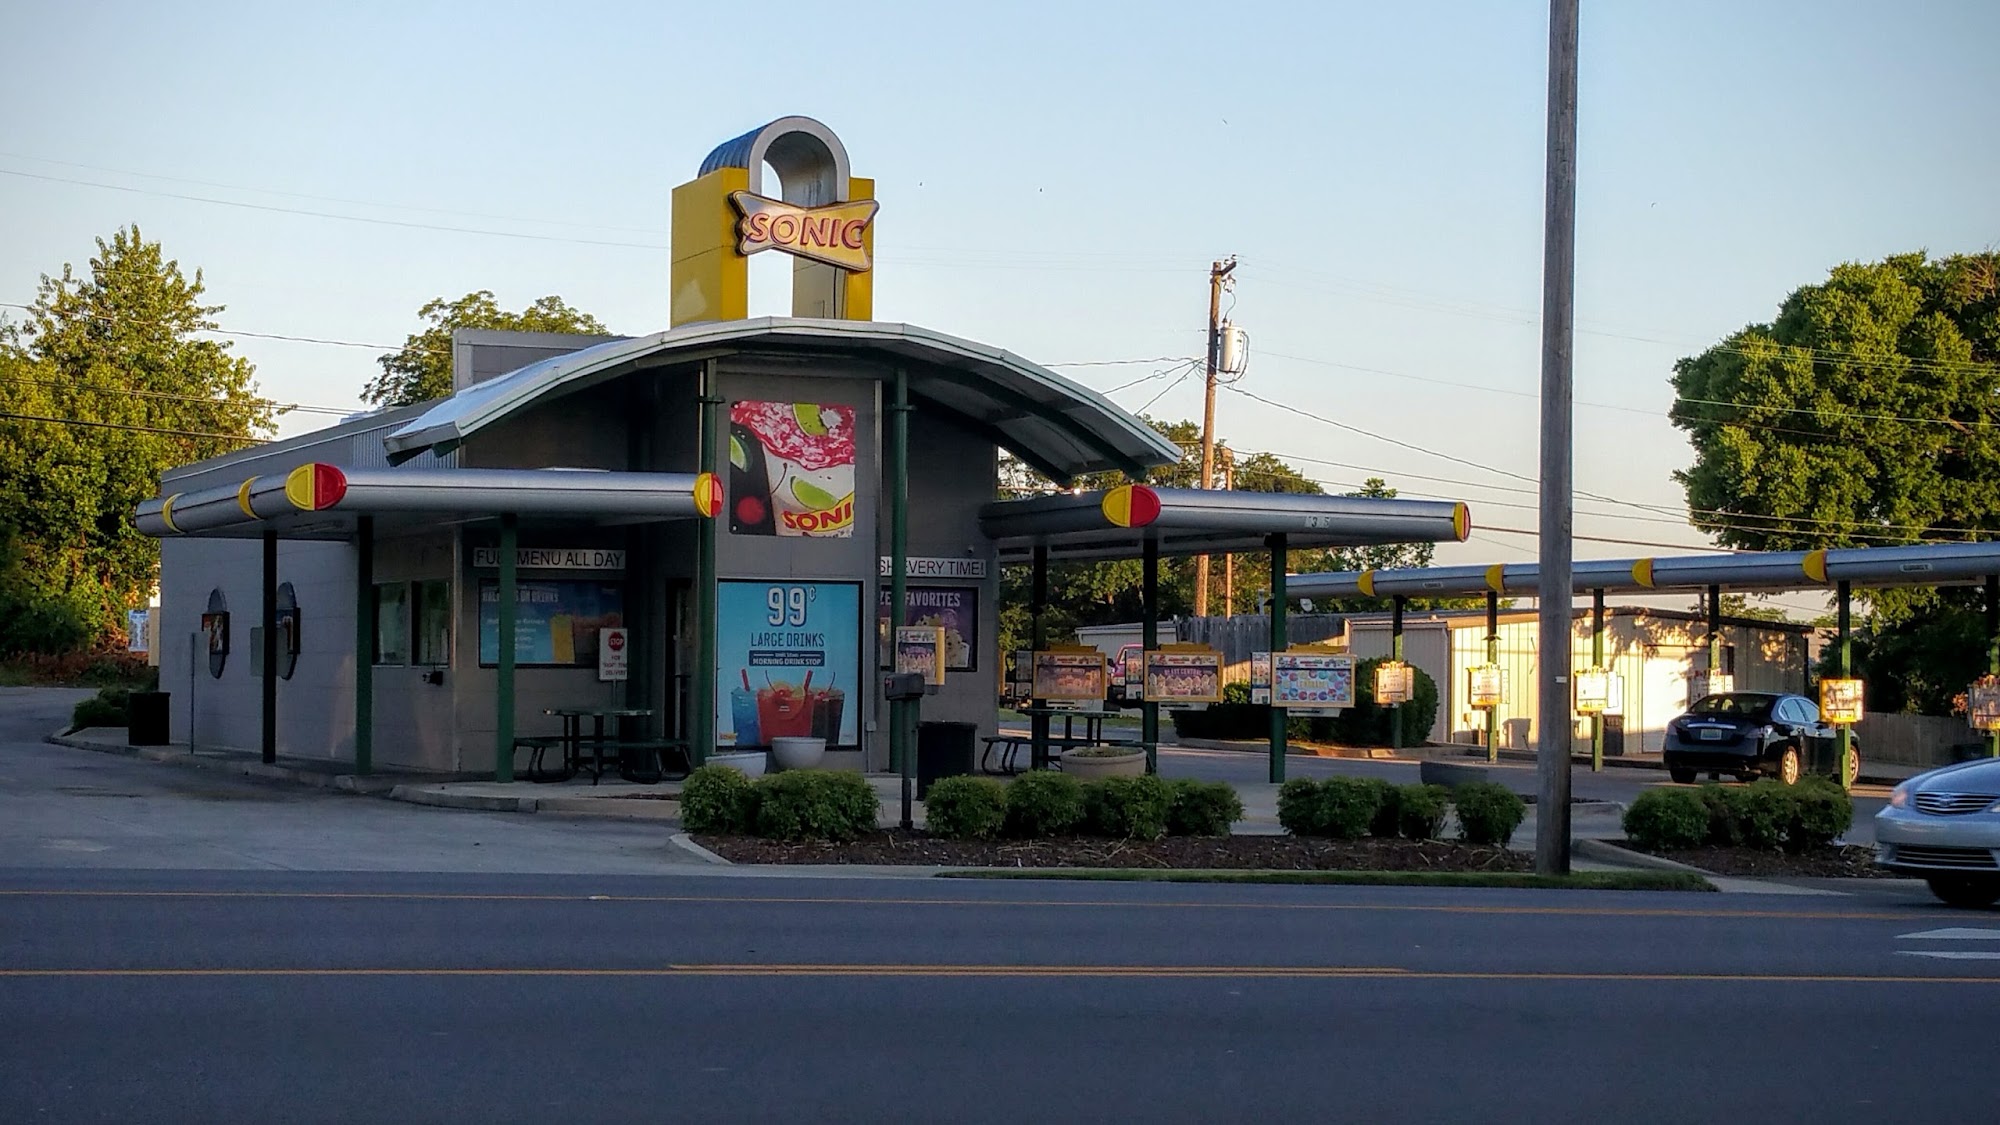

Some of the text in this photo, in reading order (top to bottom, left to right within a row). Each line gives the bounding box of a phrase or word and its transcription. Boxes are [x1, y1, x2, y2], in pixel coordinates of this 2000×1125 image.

[745, 213, 865, 249] SONIC
[781, 502, 852, 531] SONI
[476, 549, 624, 567] FU MENU ALL DAY
[906, 560, 945, 574] VERY
[948, 561, 984, 576] TIME!
[905, 592, 961, 607] FAVORITES
[610, 637, 625, 646] STOP
[750, 632, 825, 648] LARGE DRINKS
[784, 658, 805, 666] DRINK
[805, 658, 822, 666] STOP
